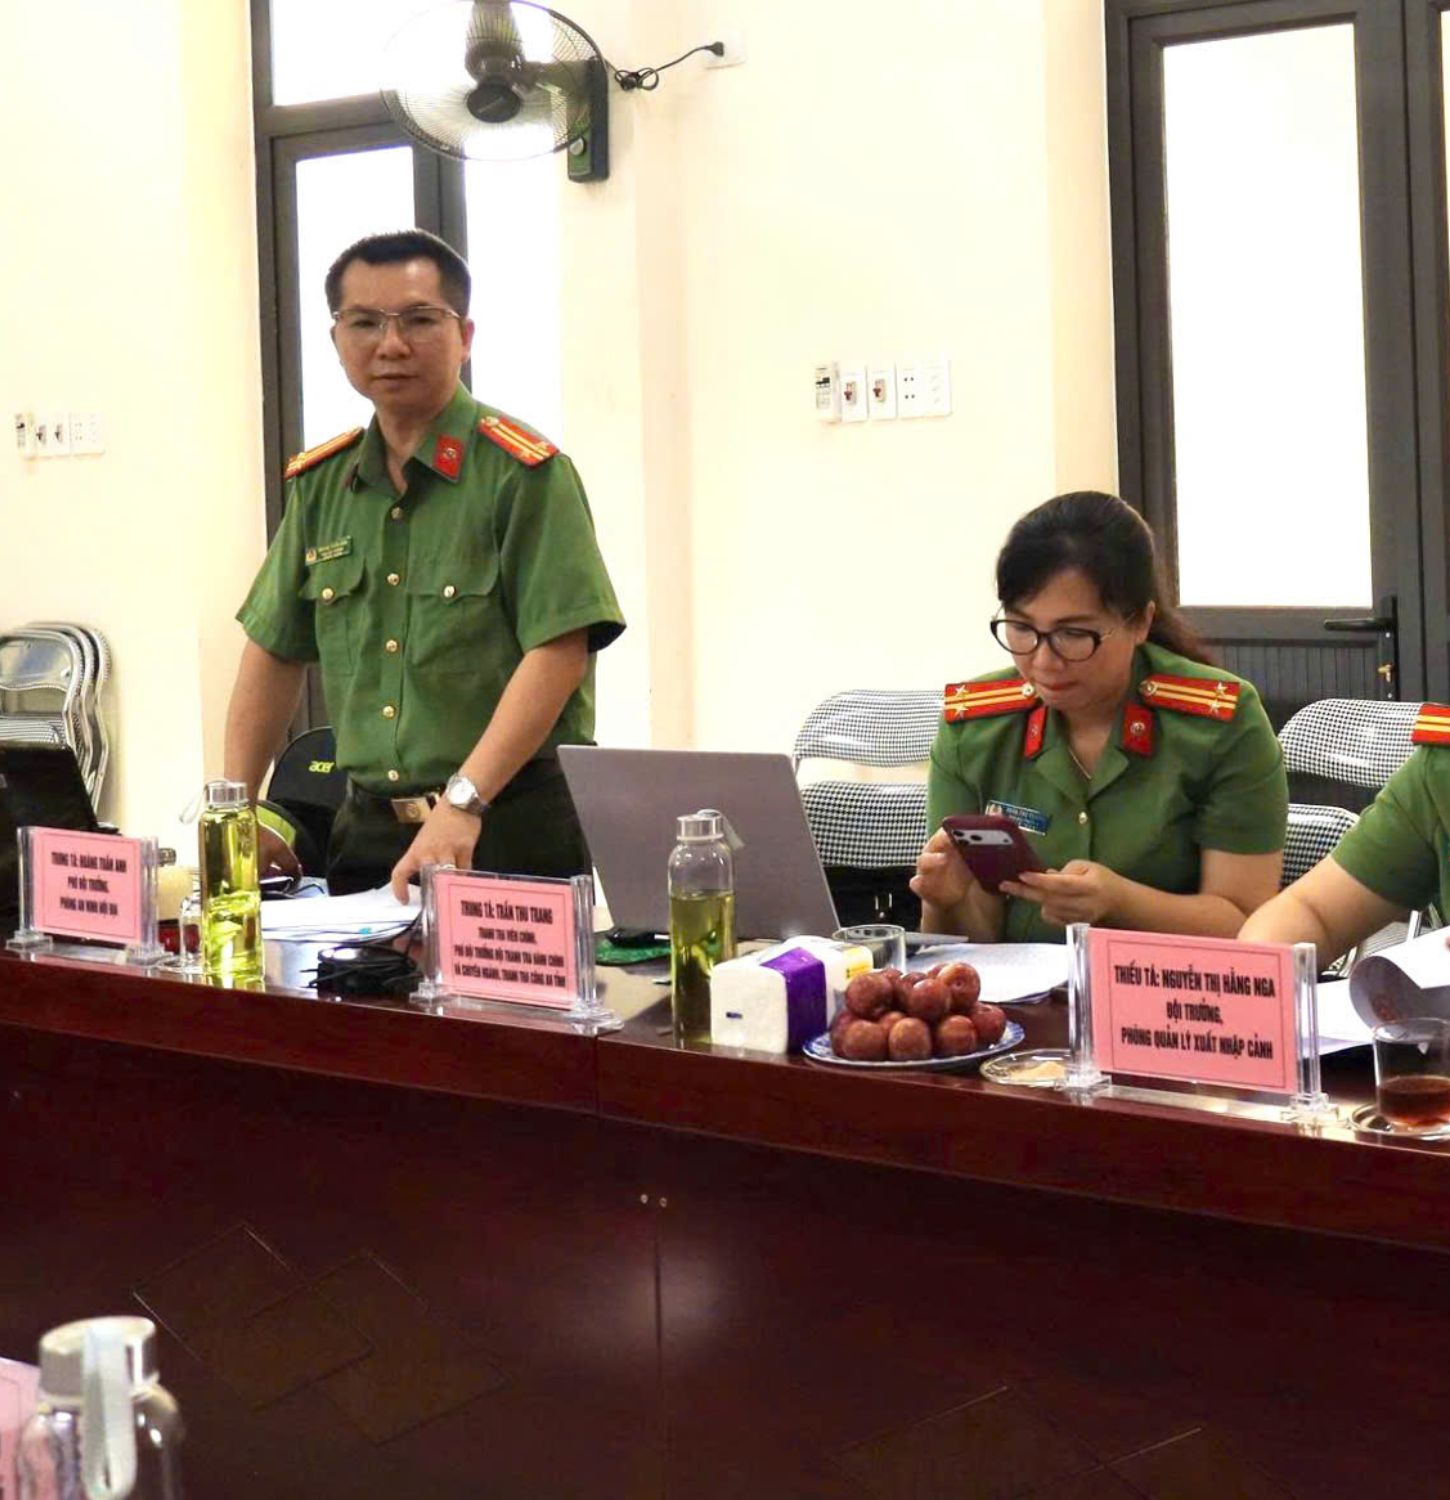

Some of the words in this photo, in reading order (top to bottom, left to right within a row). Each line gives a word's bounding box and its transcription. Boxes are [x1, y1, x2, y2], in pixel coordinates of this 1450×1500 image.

[461, 900, 482, 918] TRUNG
[484, 899, 494, 919] TÁ:
[516, 906, 528, 922] THU
[530, 907, 553, 924] TRANG
[1114, 959, 1142, 985] THIẾU
[1144, 964, 1159, 987] TÁ:
[1162, 964, 1202, 991] NGUYỄN
[1204, 973, 1221, 997] THỊ
[1253, 976, 1276, 998] NGA
[1166, 998, 1182, 1023] ĐỘI
[1122, 1024, 1152, 1046] PHÒNG
[1154, 1024, 1178, 1050] QUẢN
[1181, 1030, 1190, 1050] LÝ
[1194, 1030, 1217, 1052] XUẤT
[1220, 1034, 1245, 1059] NHẬP
[1248, 1033, 1273, 1059] CẢNH
